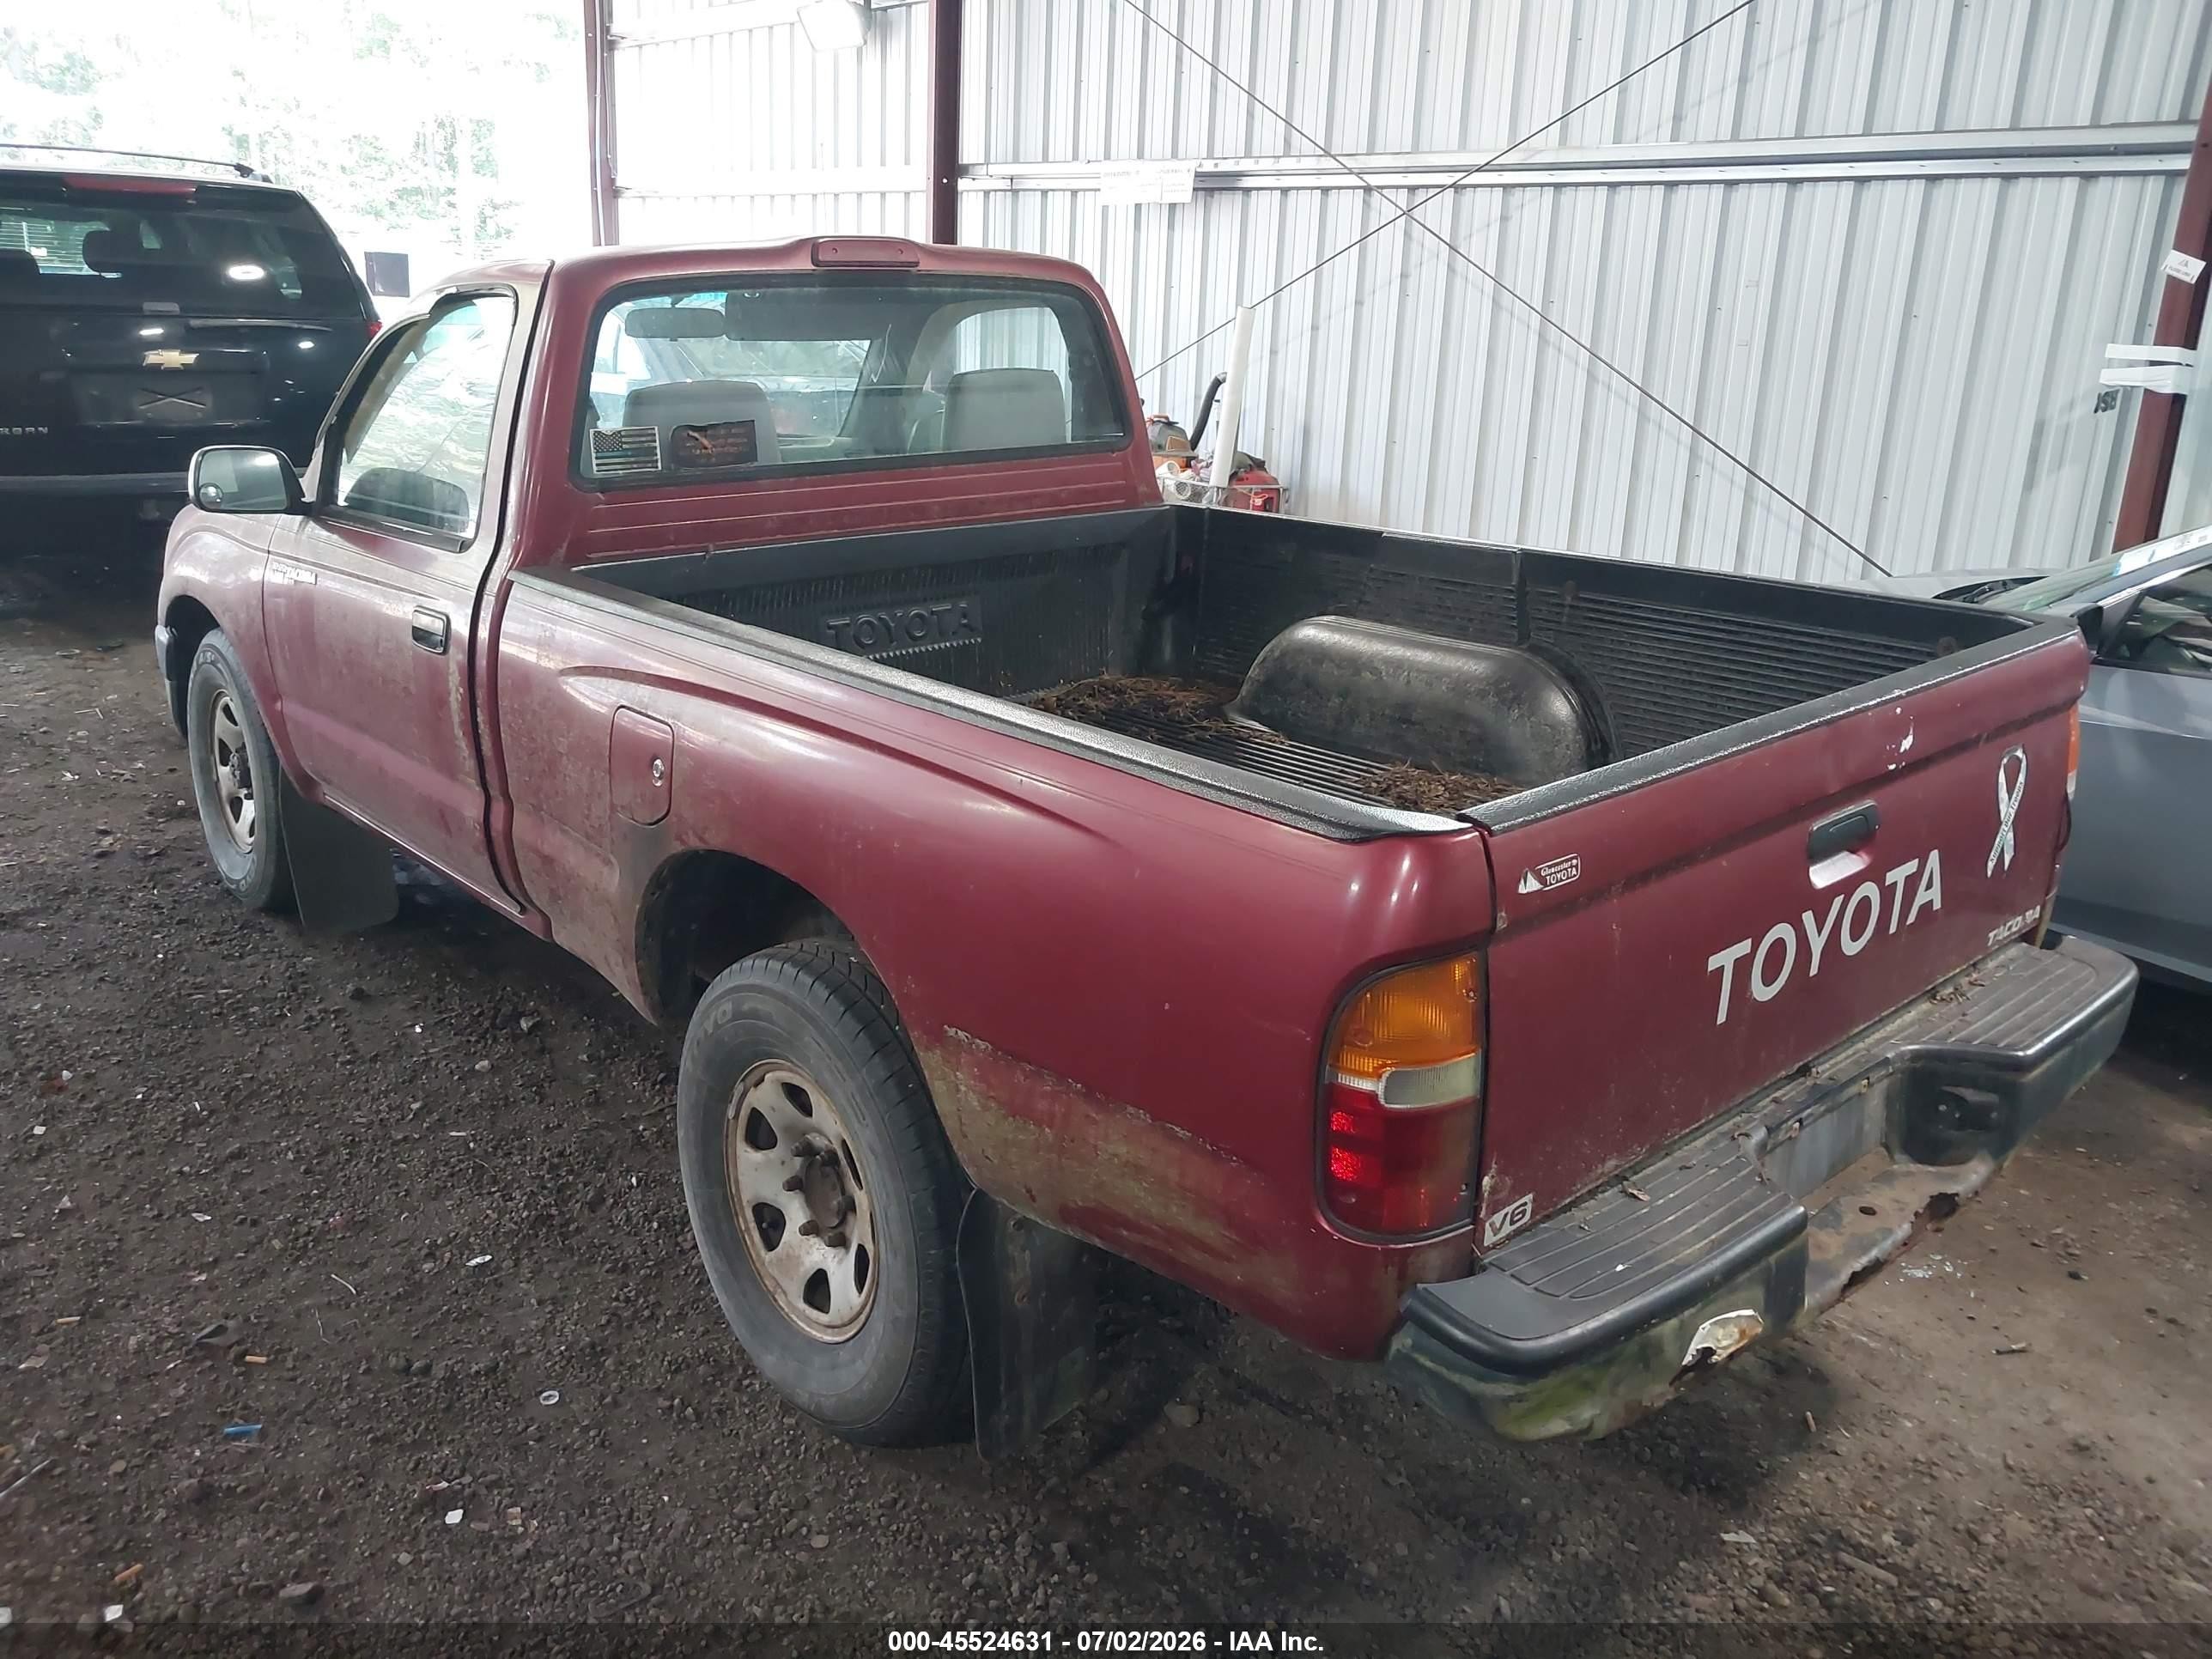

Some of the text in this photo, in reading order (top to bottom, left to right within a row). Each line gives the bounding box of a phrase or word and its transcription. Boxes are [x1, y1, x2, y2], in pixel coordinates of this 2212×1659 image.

[827, 602, 981, 649] TOYOTA
[1990, 826, 2007, 864] Support
[2011, 781, 2024, 810] Troops
[1540, 860, 1571, 877] Gloucester
[1546, 866, 1577, 885] TOYOTA
[1708, 848, 1942, 1025] TOYOTA
[1488, 1200, 1528, 1237] V6
